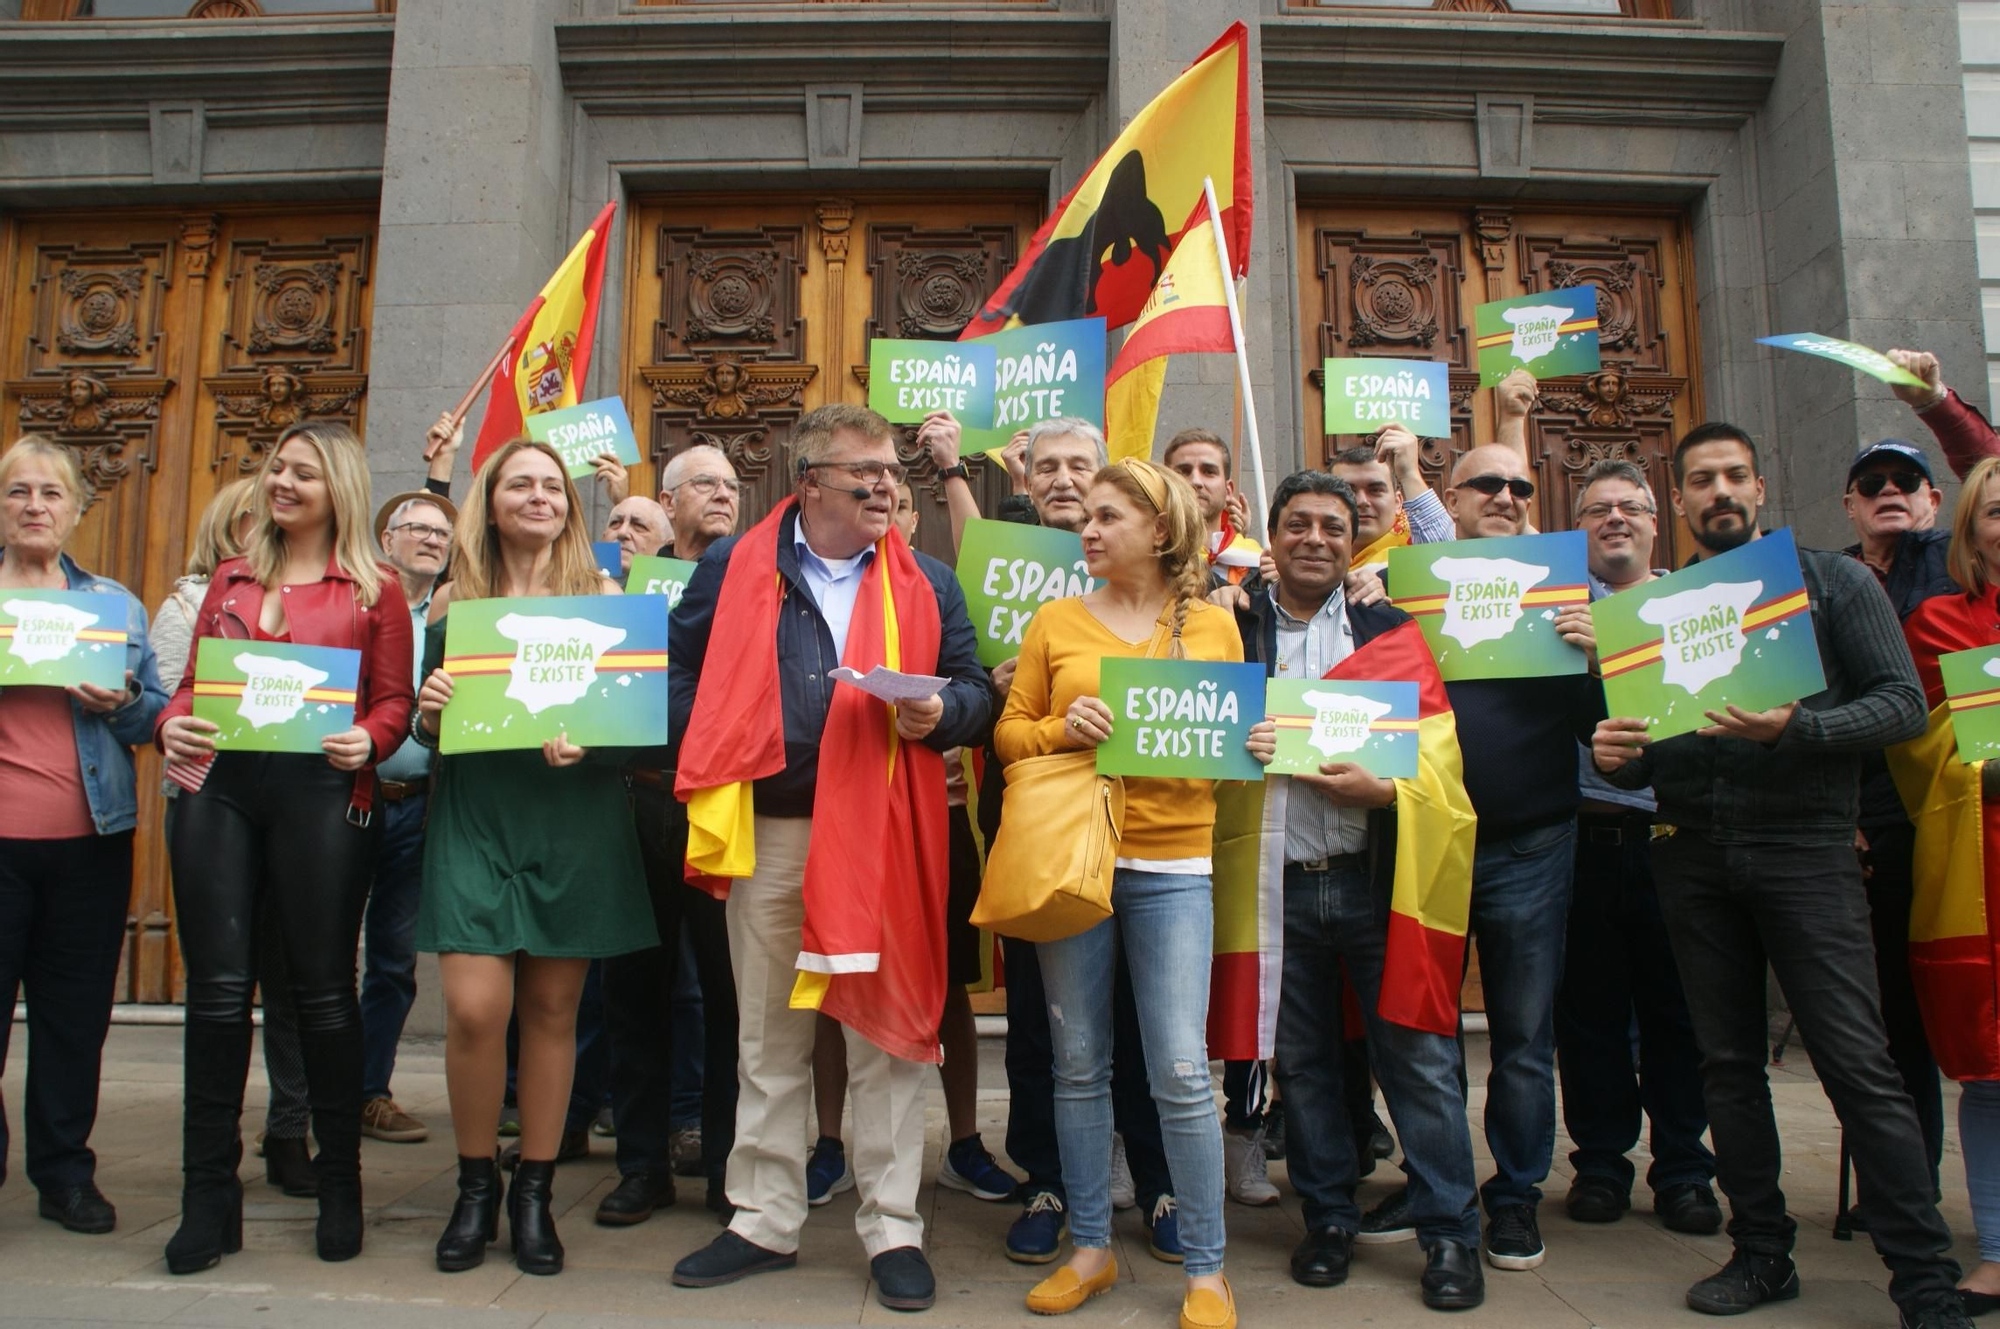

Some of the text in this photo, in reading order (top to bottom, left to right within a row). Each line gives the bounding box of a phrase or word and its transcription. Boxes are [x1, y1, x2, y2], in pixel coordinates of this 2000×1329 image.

[1517, 316, 1557, 336] ESPAÑA
[1522, 332, 1553, 346] EXISTE
[890, 354, 977, 388] ESPAÑA
[1345, 370, 1431, 400] ESPAÑA
[898, 387, 967, 411] EXISTE
[995, 389, 1065, 428] XISTE
[1354, 399, 1422, 420] EXISTE
[547, 412, 618, 449] ESPAÑA
[561, 437, 617, 467] EXISTE
[983, 557, 1095, 602] ESPAÑ
[1454, 576, 1520, 602] ESPAÑA
[1461, 602, 1513, 621] EXISTE
[22, 616, 75, 633] ESPAÑA
[1669, 604, 1738, 645] ESPAÑA
[26, 633, 70, 646] EXISTE
[523, 637, 594, 663] ESPAÑA
[1680, 631, 1735, 663] EXISTE
[251, 673, 304, 693] ESPAÑA
[529, 665, 586, 683] EXISTE
[255, 693, 296, 707] EXISTE
[1126, 680, 1239, 724] ESPAÑA
[1320, 708, 1369, 725] ESPAÑA
[1136, 727, 1227, 758] EXISTE
[1324, 725, 1364, 738] EXISTE
